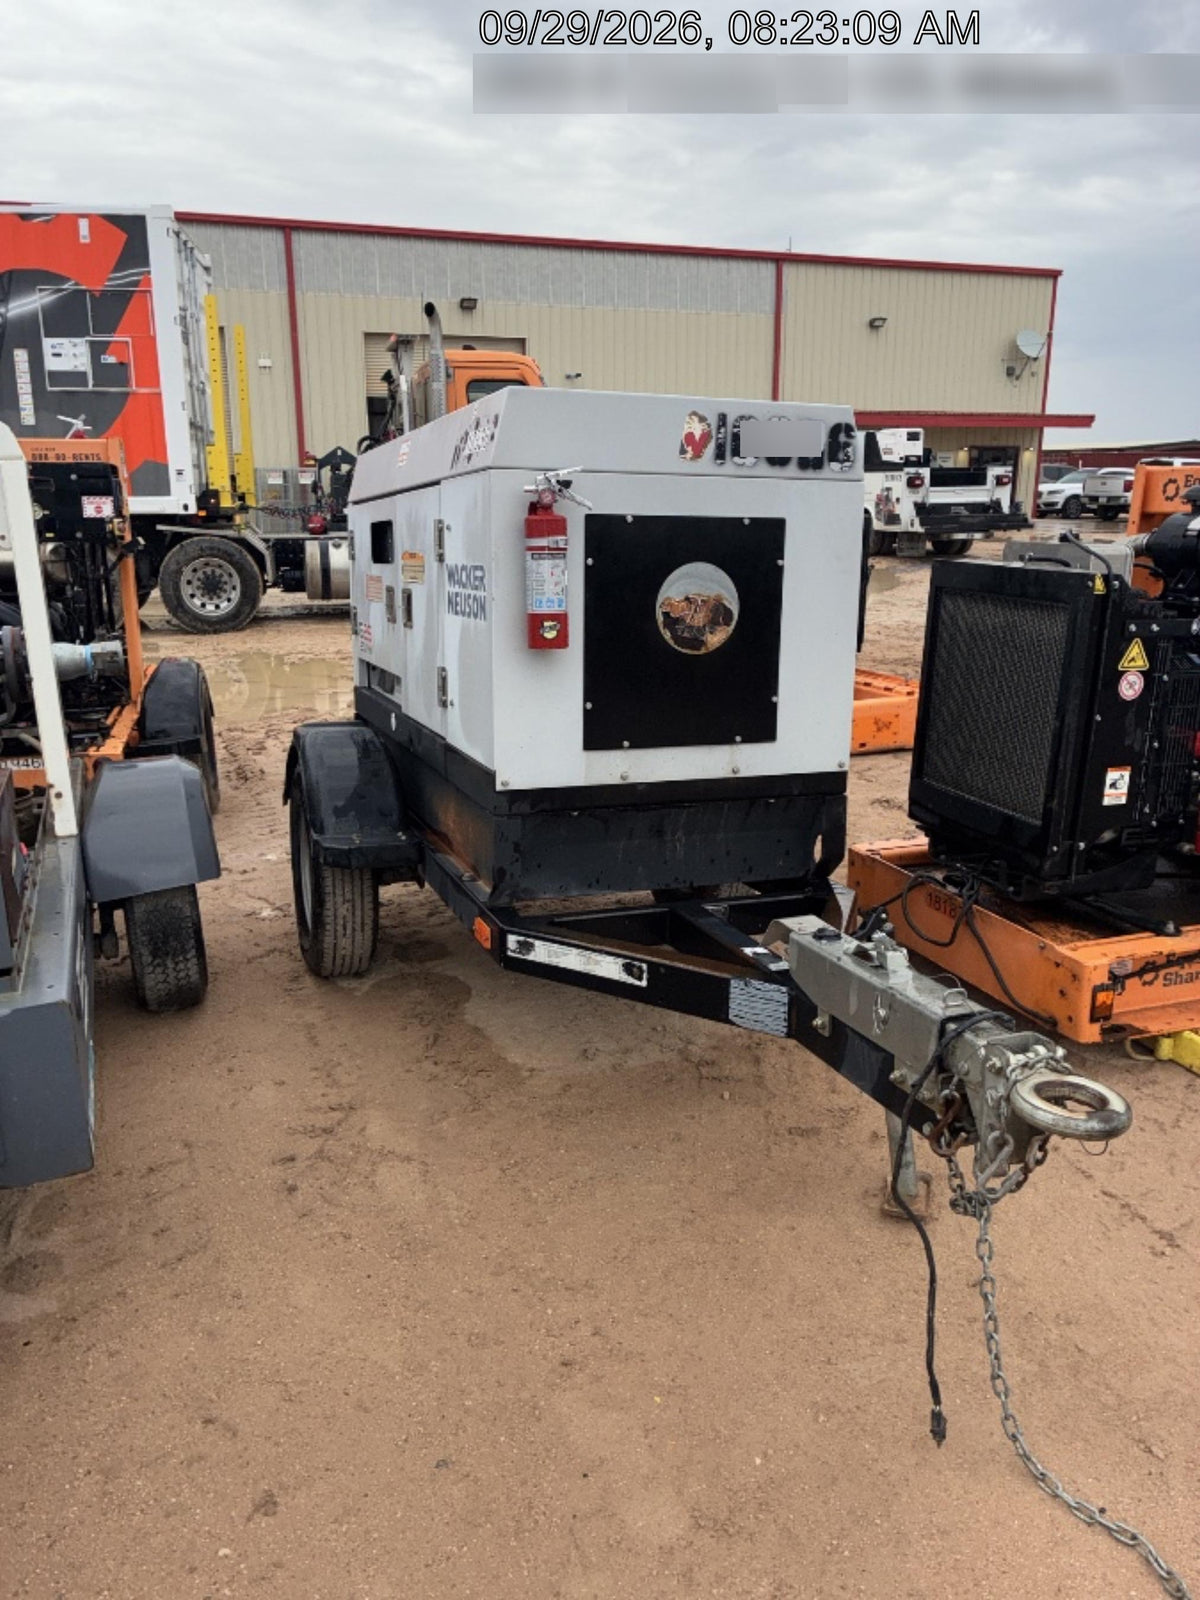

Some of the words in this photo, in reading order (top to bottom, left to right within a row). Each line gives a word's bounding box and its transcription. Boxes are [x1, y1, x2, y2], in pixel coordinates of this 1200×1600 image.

[446, 563, 486, 592] WACKER
[447, 591, 487, 621] NEUSON
[927, 892, 963, 919] 1818
